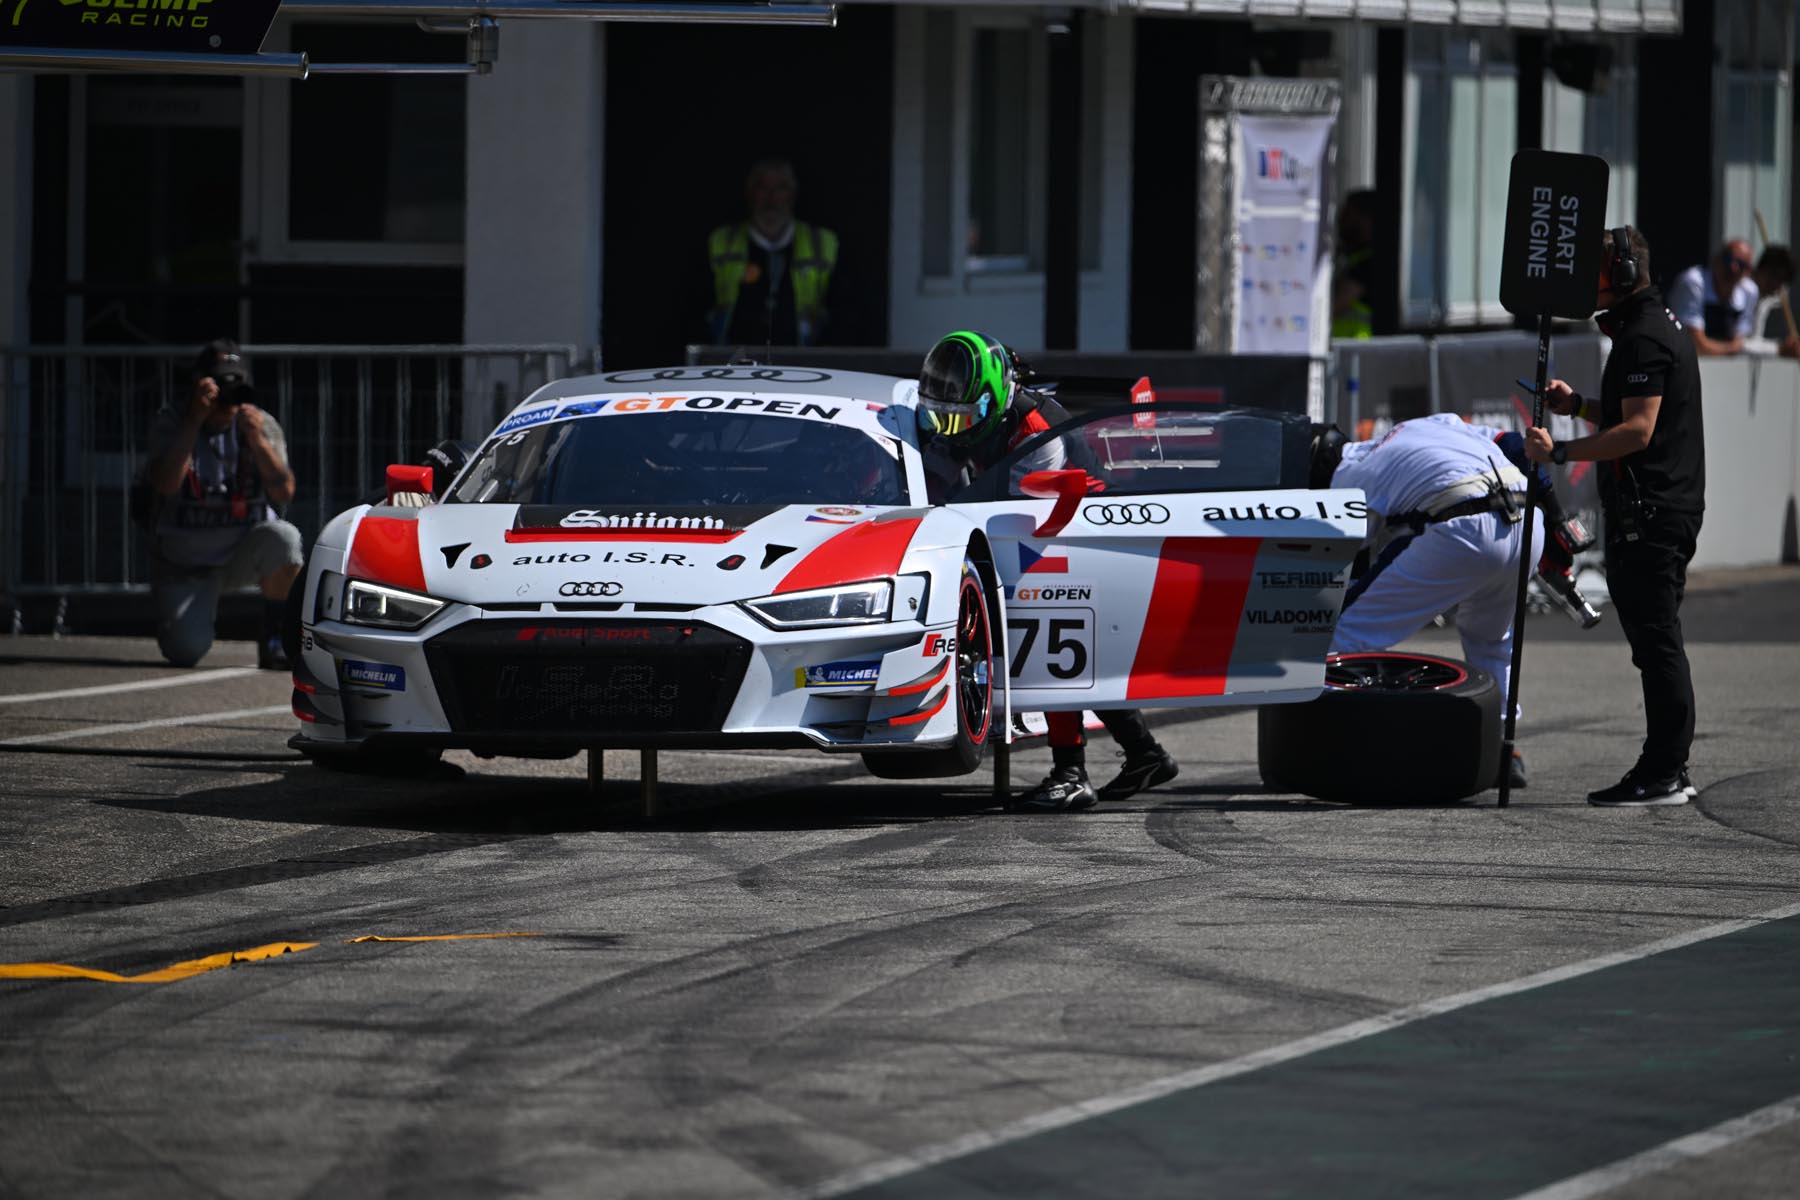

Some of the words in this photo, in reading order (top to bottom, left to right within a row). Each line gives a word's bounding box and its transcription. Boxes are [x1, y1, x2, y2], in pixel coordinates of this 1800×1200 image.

[81, 12, 208, 28] RACING
[1527, 186, 1552, 278] ENGINE
[1555, 195, 1578, 275] START
[502, 409, 554, 430] PROAM
[1202, 503, 1301, 521] auto
[512, 552, 591, 566] auto
[603, 551, 695, 567] I.S.R.
[1247, 610, 1333, 624] VILADOMY
[544, 627, 589, 639] Audi
[594, 627, 650, 641] Sport
[1007, 618, 1088, 680] 75
[351, 669, 397, 683] MICHELIN
